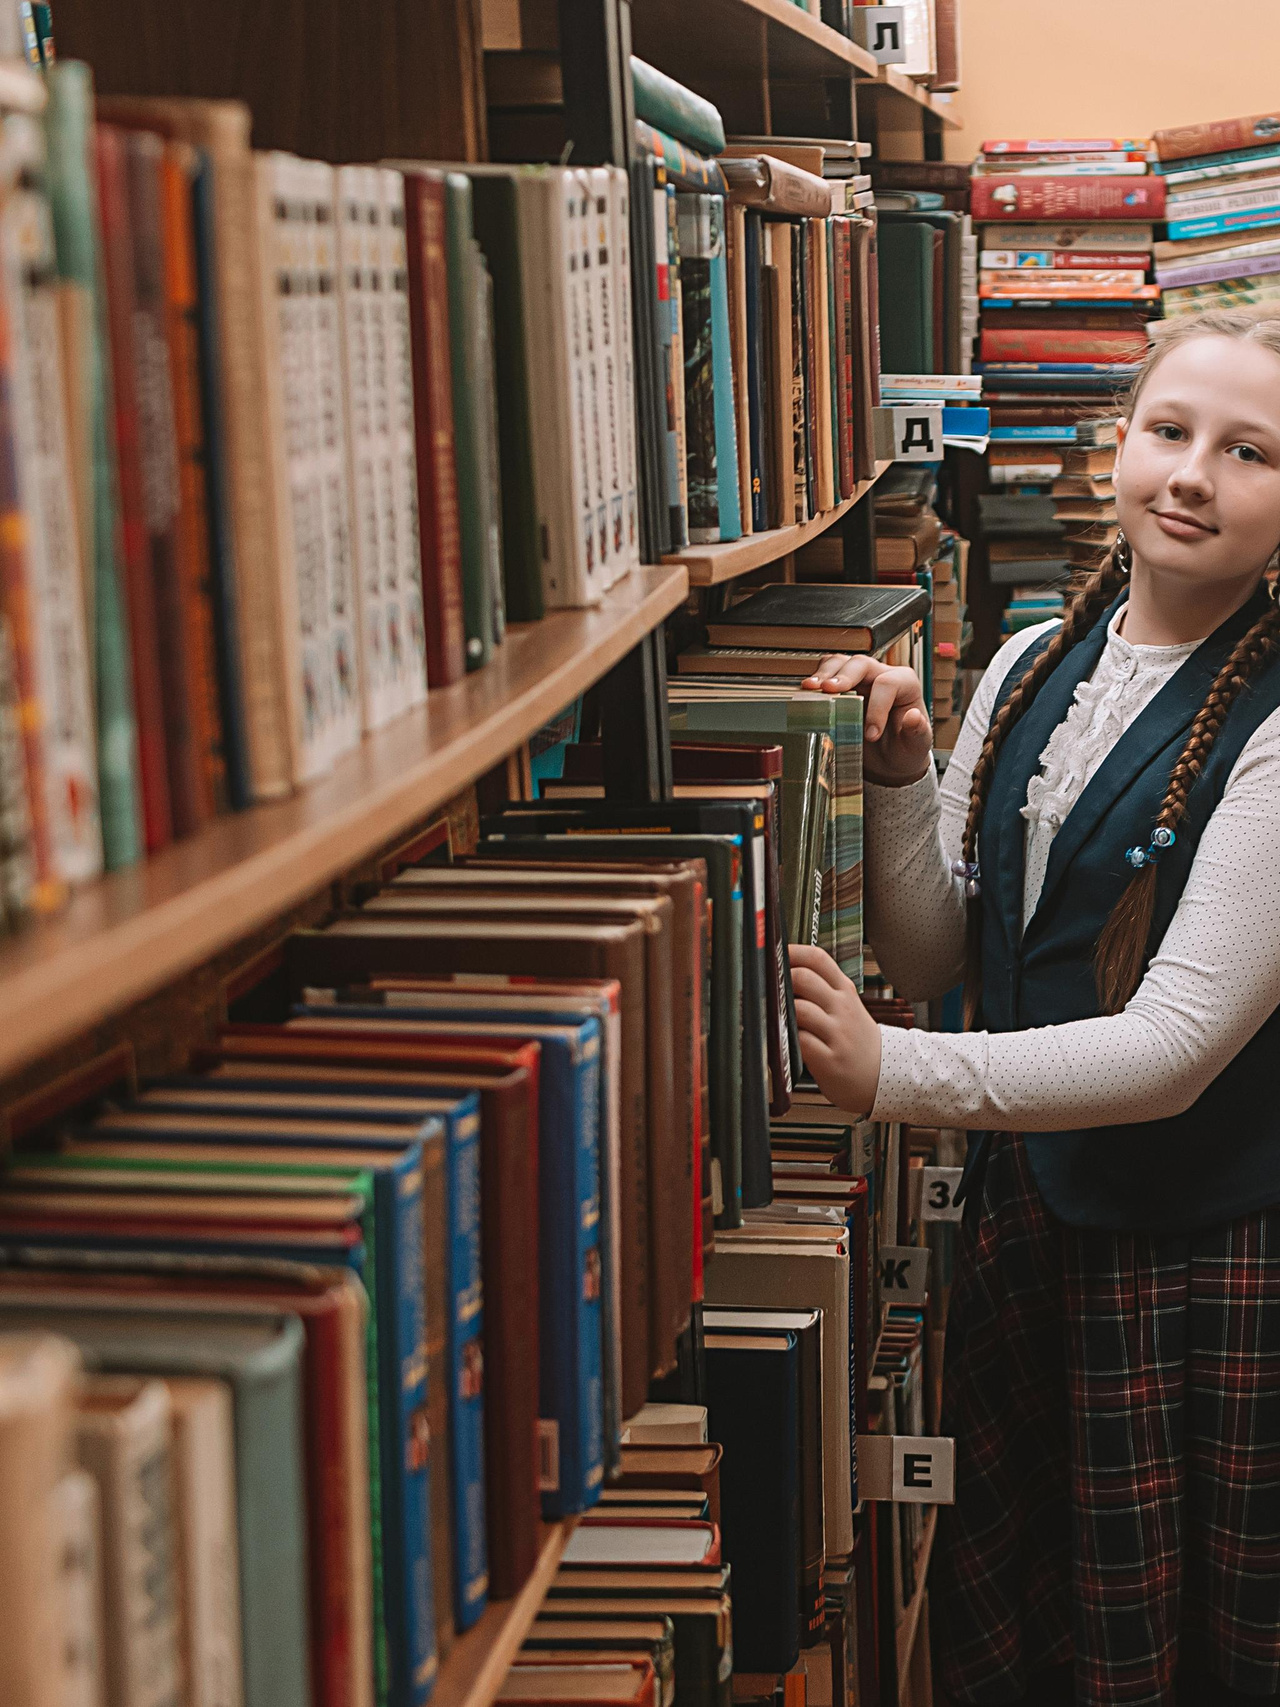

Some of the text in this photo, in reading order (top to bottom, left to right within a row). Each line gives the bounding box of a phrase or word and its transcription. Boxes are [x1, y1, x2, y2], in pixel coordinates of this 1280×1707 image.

[873, 22, 900, 50] Л
[901, 417, 935, 454] Д
[903, 1453, 933, 1489] Е
